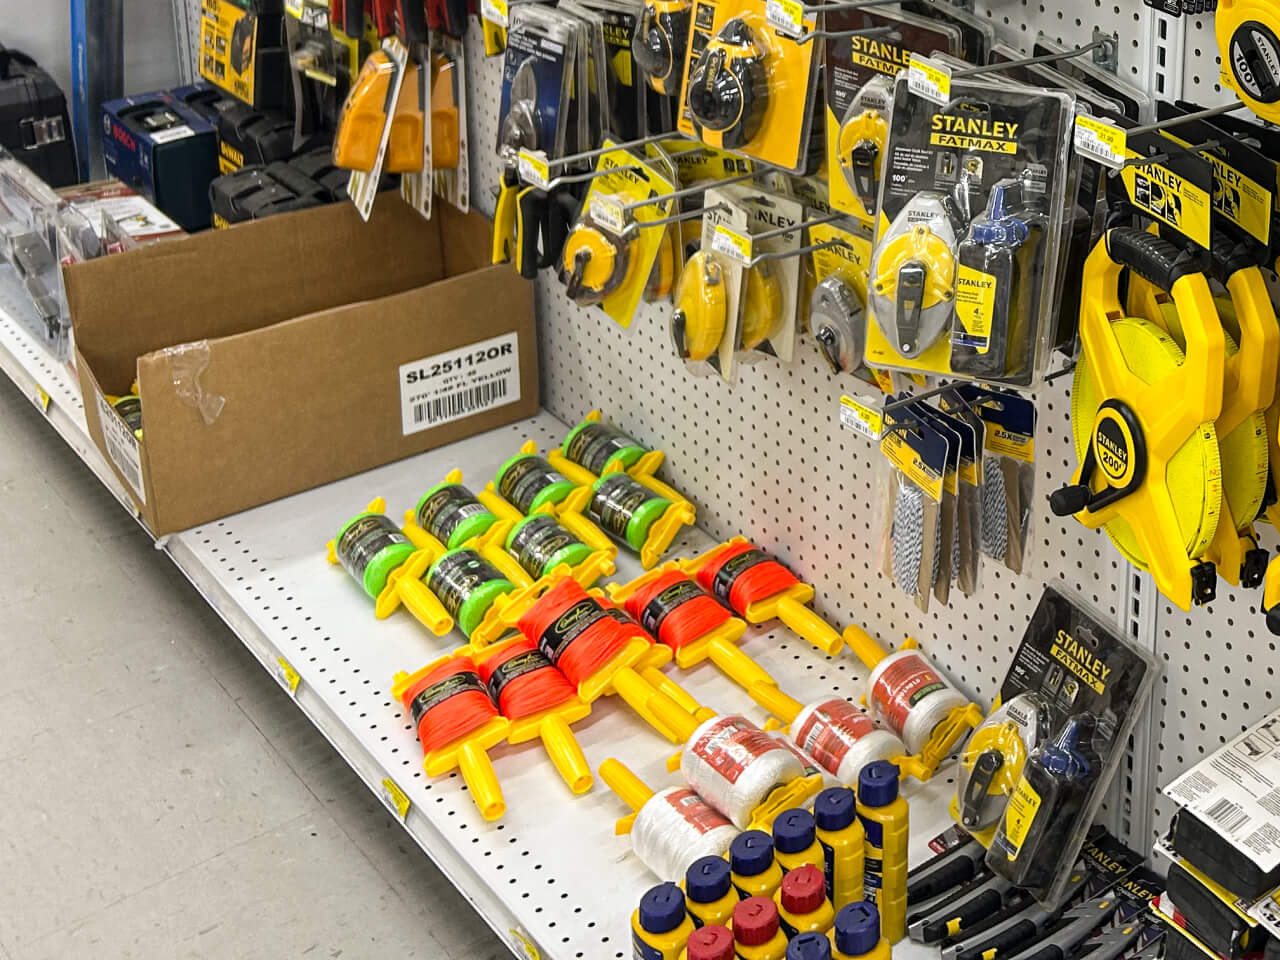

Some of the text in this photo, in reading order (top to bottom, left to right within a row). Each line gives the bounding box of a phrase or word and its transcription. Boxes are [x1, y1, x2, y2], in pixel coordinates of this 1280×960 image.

[852, 35, 912, 64] STANLE
[1255, 34, 1279, 80] STANLEY
[1236, 54, 1257, 91] 100'
[931, 114, 1017, 139] STANLEY
[938, 135, 1008, 152] FATMAX
[604, 157, 641, 185] STANLEY
[908, 209, 941, 219] STANLEY
[958, 277, 991, 289] STANLEY
[471, 367, 513, 386] YELLOW
[1097, 431, 1128, 462] STANLEY
[1102, 451, 1125, 470] 200'
[1056, 630, 1112, 682] STANLEY
[1055, 649, 1098, 692] FATMAX
